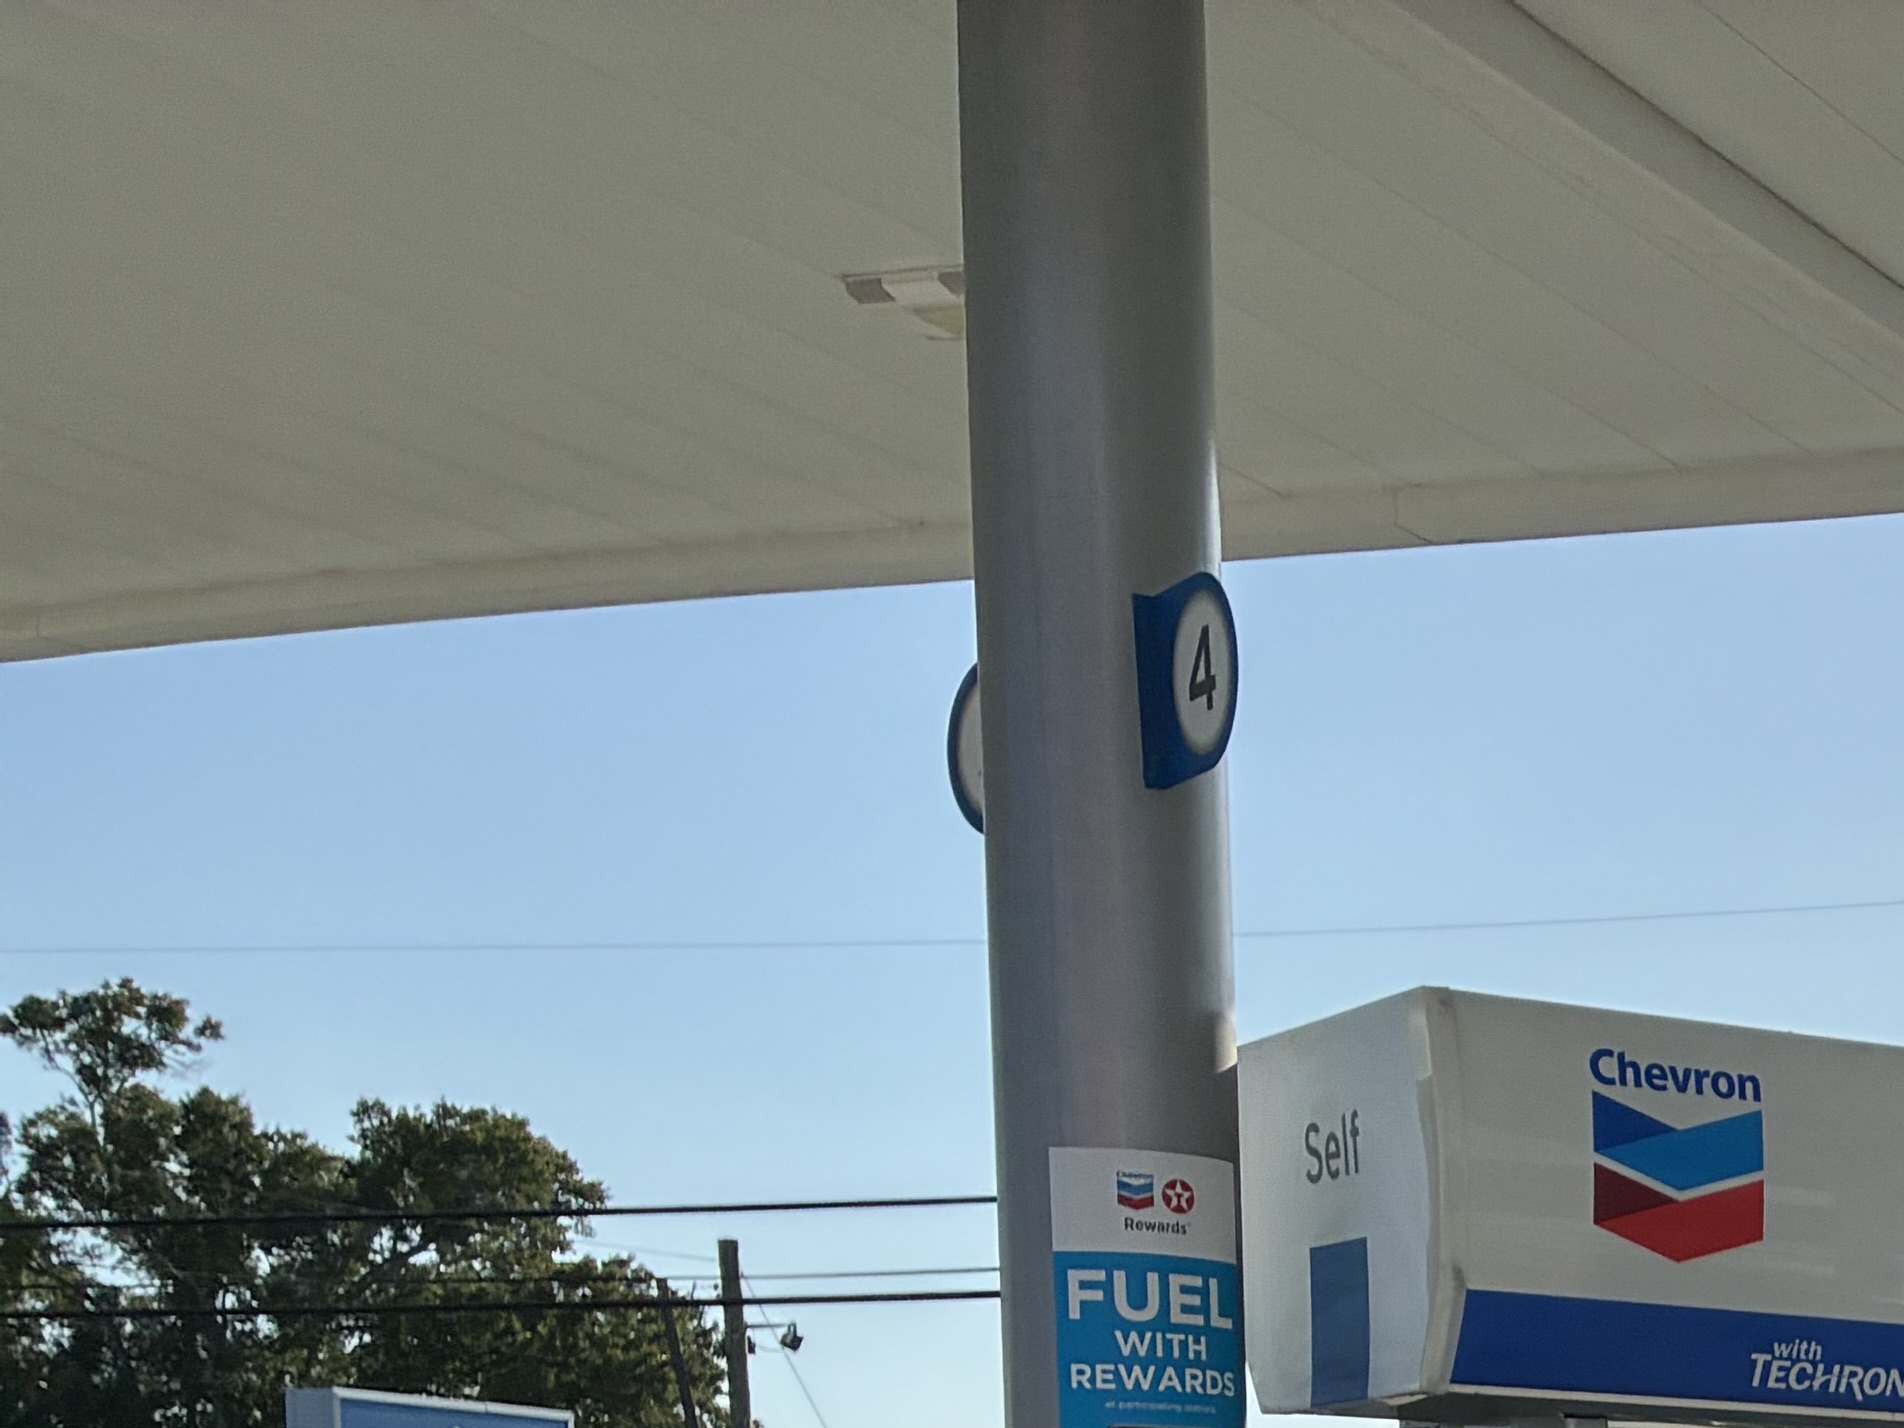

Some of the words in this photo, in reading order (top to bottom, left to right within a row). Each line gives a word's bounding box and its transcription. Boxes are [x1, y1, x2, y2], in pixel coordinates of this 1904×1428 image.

[1189, 624, 1217, 711] 4
[1589, 1048, 1762, 1102] Chevron
[1305, 1109, 1359, 1184] Self
[1124, 1216, 1187, 1235] Rewards
[1067, 1269, 1233, 1330] FUEL
[1115, 1330, 1207, 1361] WITH
[1773, 1339, 1822, 1361] with
[1070, 1363, 1235, 1397] REWARDS
